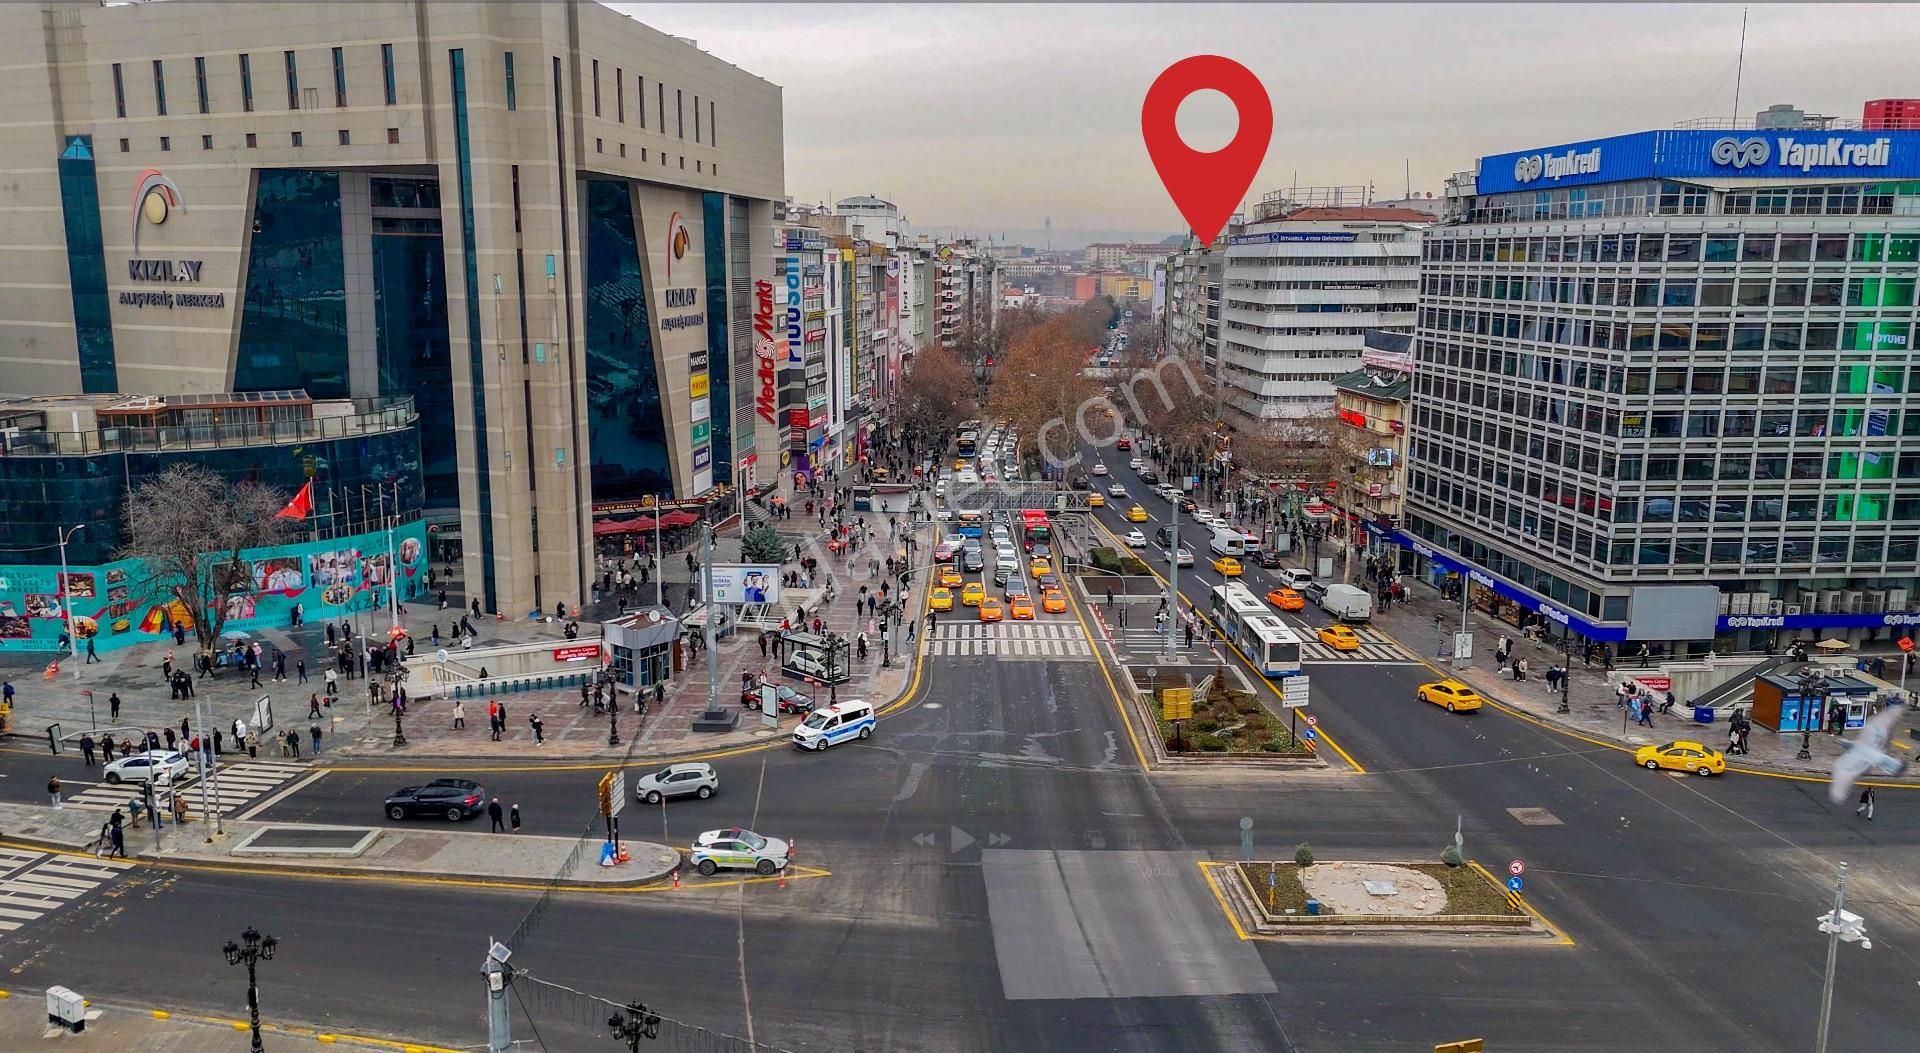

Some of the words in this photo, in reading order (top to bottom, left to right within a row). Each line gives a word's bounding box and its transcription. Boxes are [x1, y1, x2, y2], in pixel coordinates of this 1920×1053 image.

[128, 259, 203, 282] KIZILAY
[119, 290, 174, 310] ALIŞVERİŞ
[175, 292, 225, 309] MERKEZİ
[665, 287, 698, 308] KIZILAY
[754, 280, 774, 341] Markt
[690, 354, 707, 367] MANGO
[755, 358, 776, 425] Media
[695, 448, 709, 467] mavi
